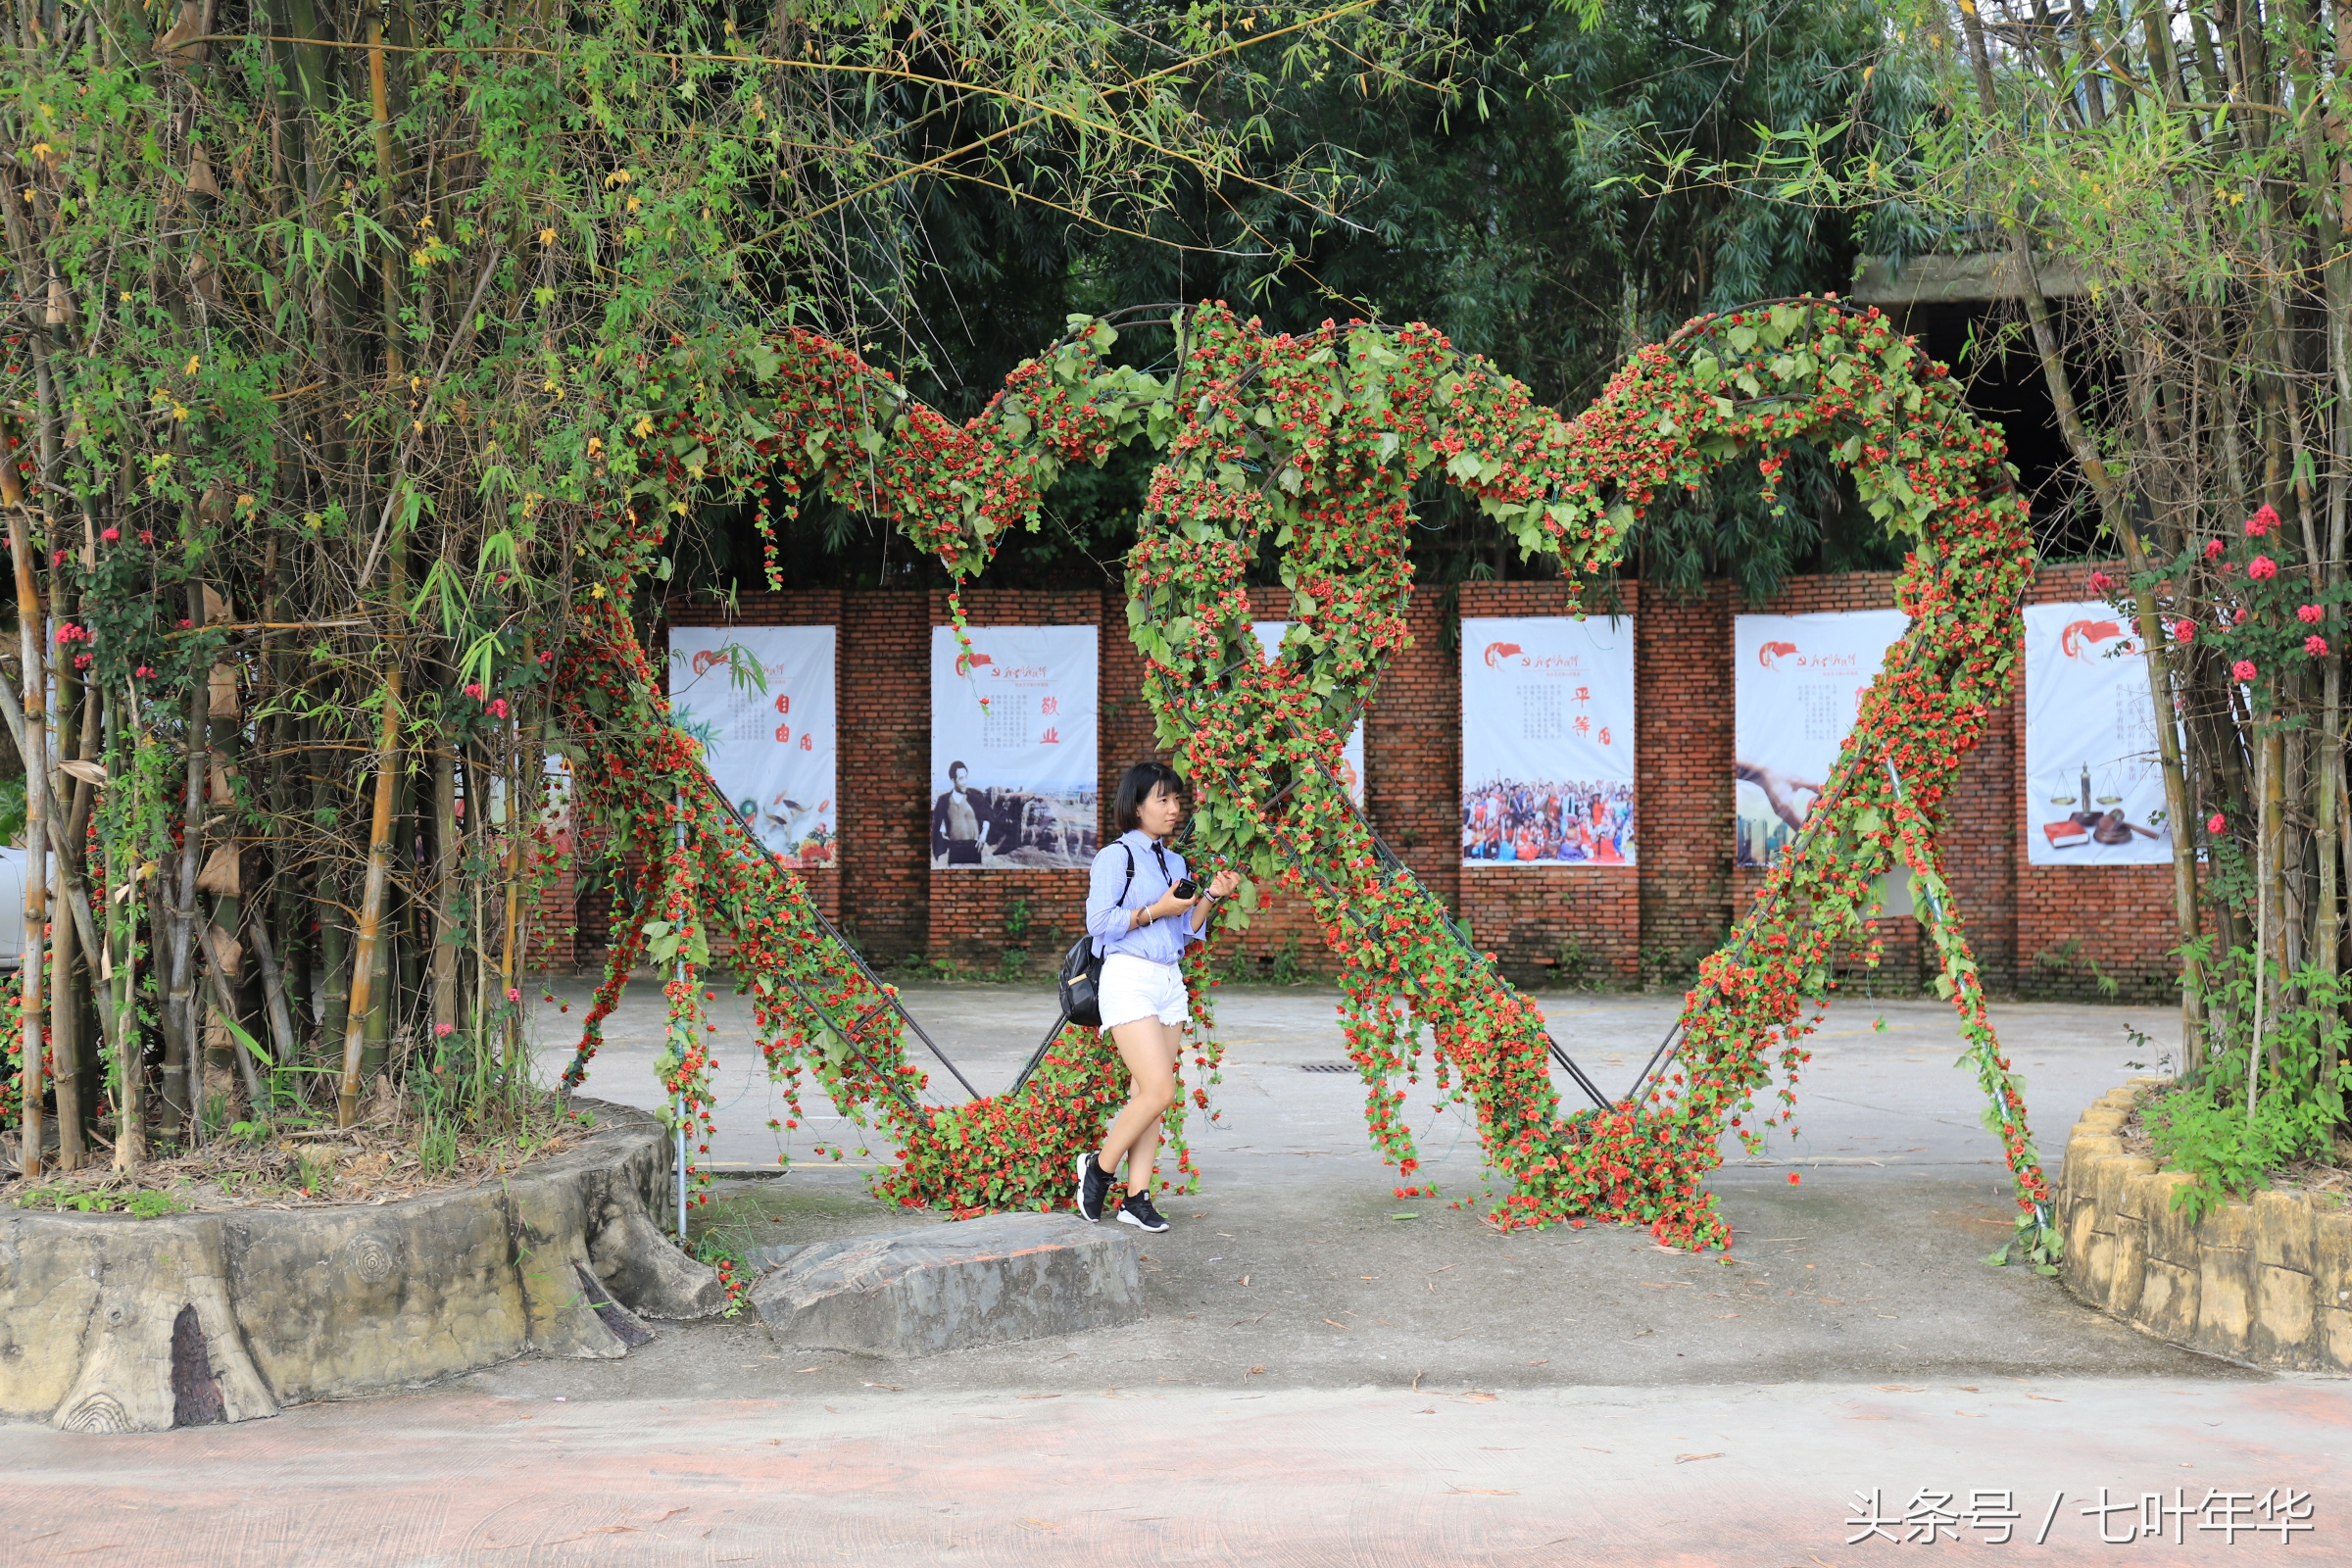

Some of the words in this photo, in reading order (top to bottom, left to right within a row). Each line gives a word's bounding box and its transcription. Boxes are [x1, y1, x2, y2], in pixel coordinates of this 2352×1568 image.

[774, 693, 790, 743] 自由
[1040, 696, 1060, 744] 敬业
[1571, 686, 1591, 739] 平等
